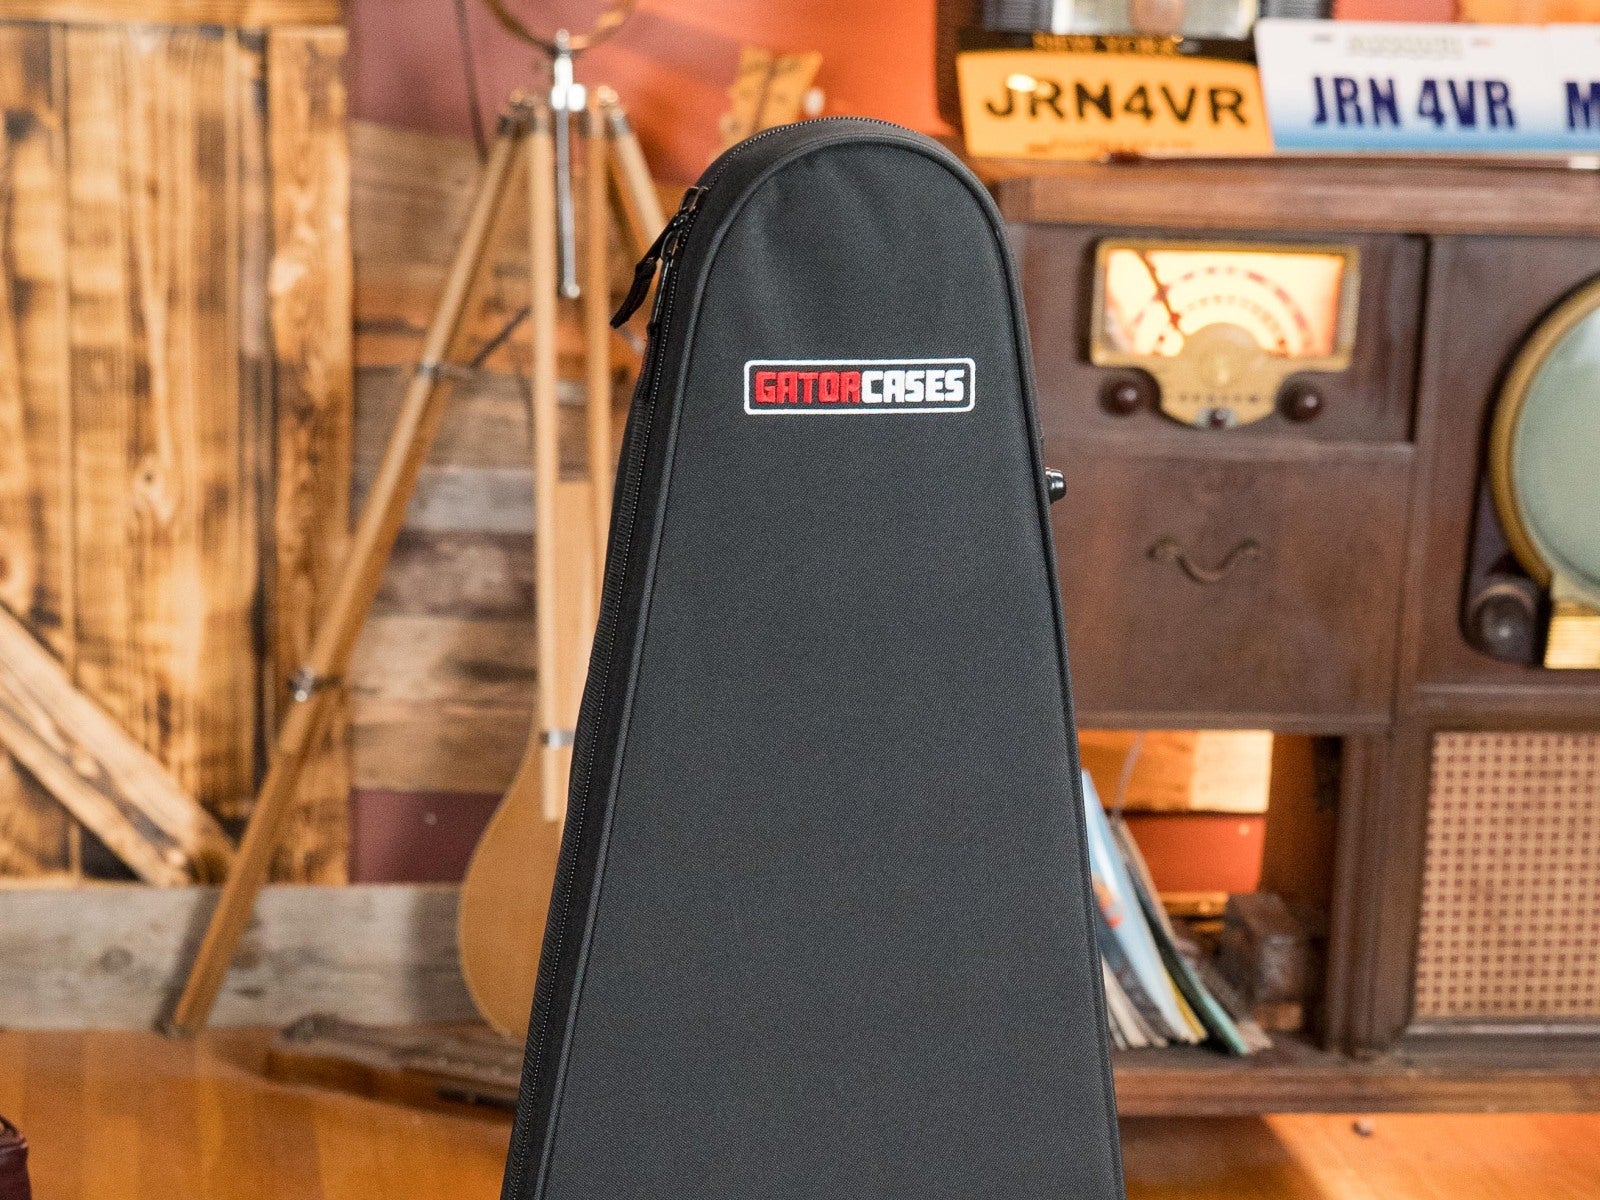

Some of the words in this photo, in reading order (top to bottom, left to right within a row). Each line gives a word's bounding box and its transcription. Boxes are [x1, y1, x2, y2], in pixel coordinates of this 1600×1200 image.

[985, 76, 1247, 126] JRN4VR
[1312, 76, 1400, 127] JRN
[1417, 78, 1516, 129] 4VR
